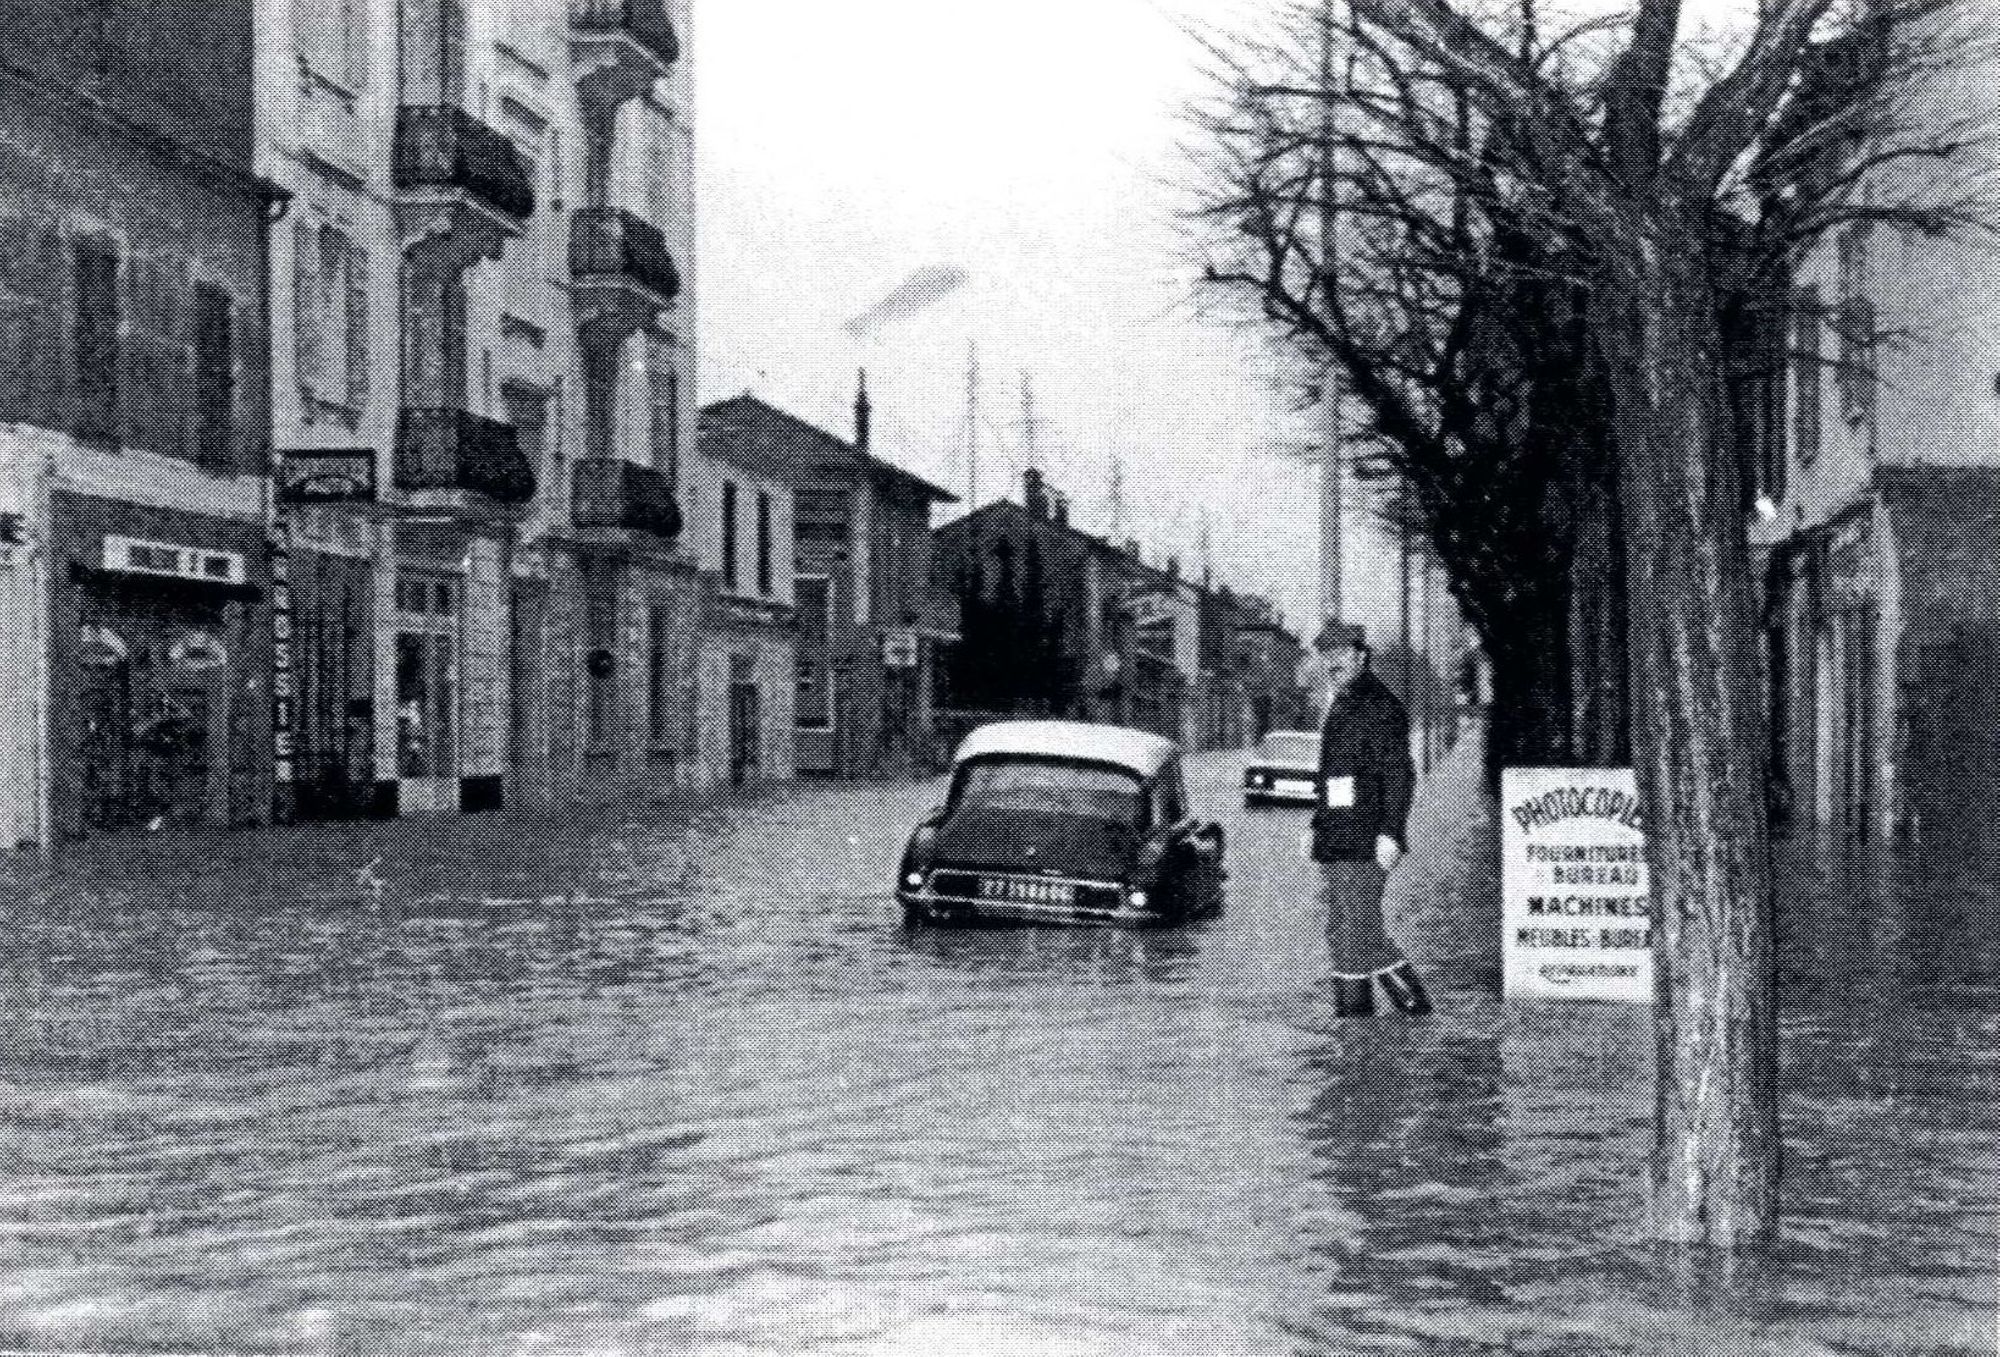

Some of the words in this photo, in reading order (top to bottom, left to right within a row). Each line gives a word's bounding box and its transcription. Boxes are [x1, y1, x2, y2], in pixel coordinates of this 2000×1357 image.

[269, 507, 293, 783] ARROSSIER
[1553, 866, 1638, 886] BUREAU
[1527, 895, 1651, 917] MACHINES
